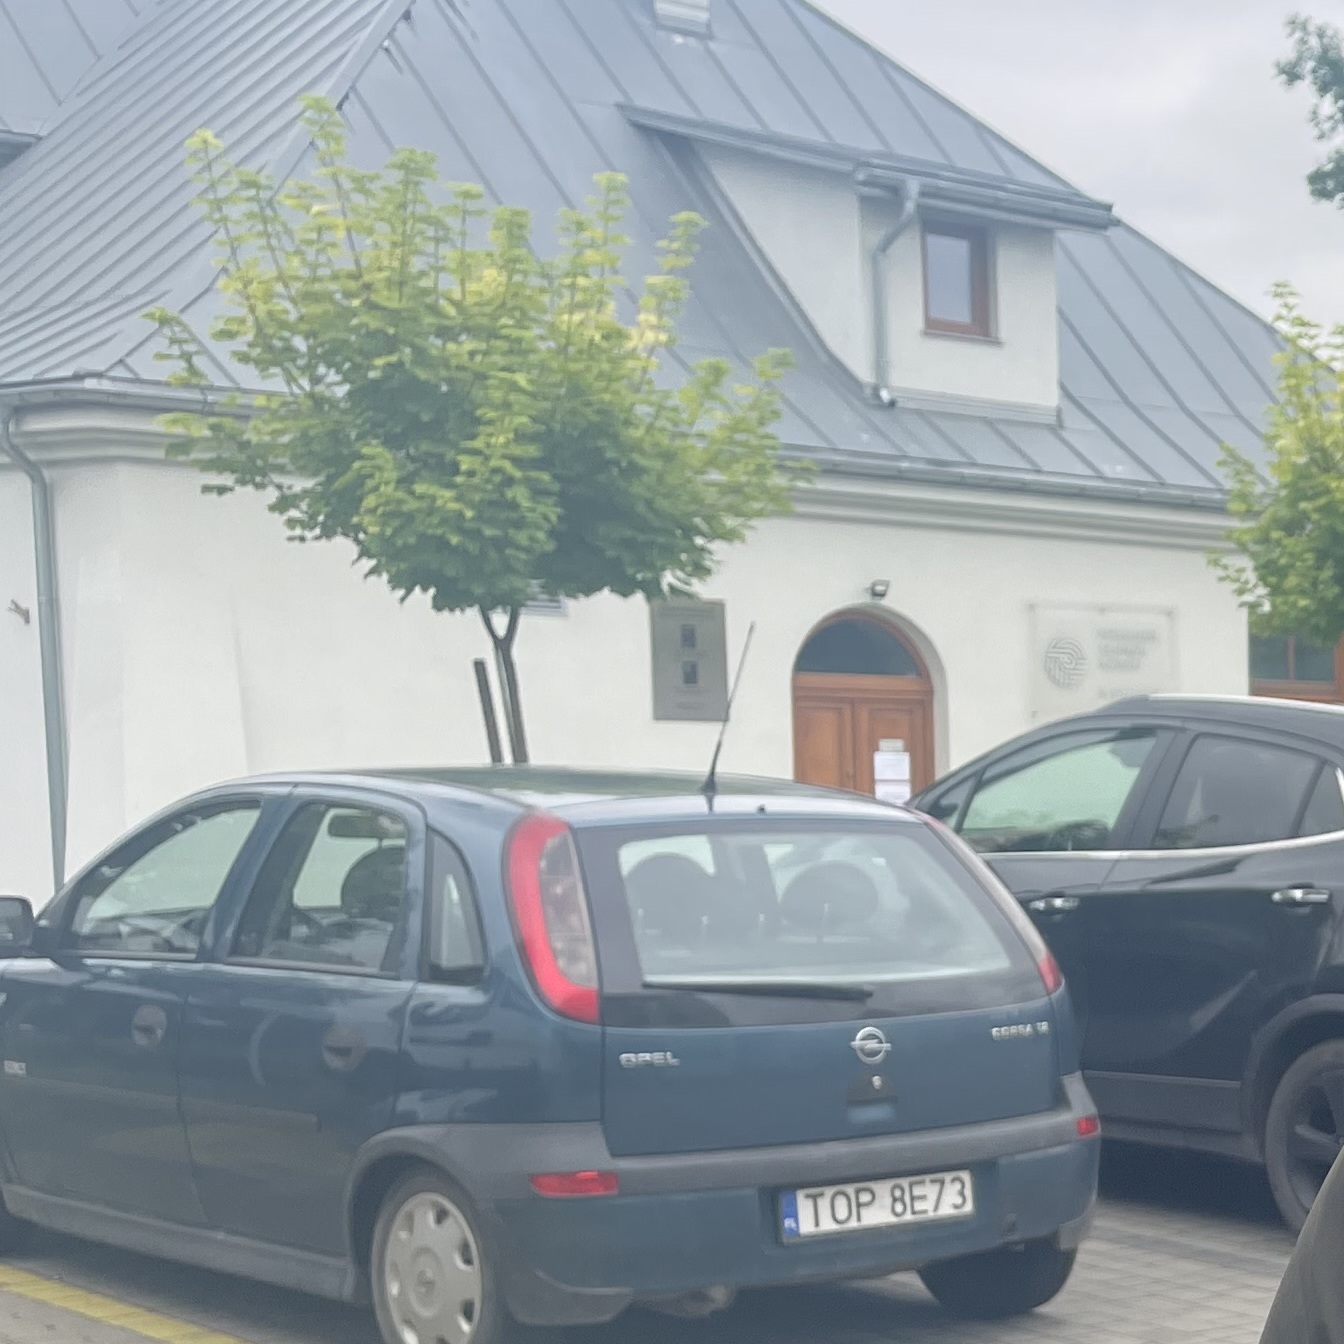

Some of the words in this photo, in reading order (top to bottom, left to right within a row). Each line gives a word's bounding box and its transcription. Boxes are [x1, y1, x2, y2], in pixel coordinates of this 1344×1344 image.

[618, 1051, 680, 1068] OPEL
[805, 1186, 876, 1228] TOP
[890, 1174, 968, 1217] 8E73
